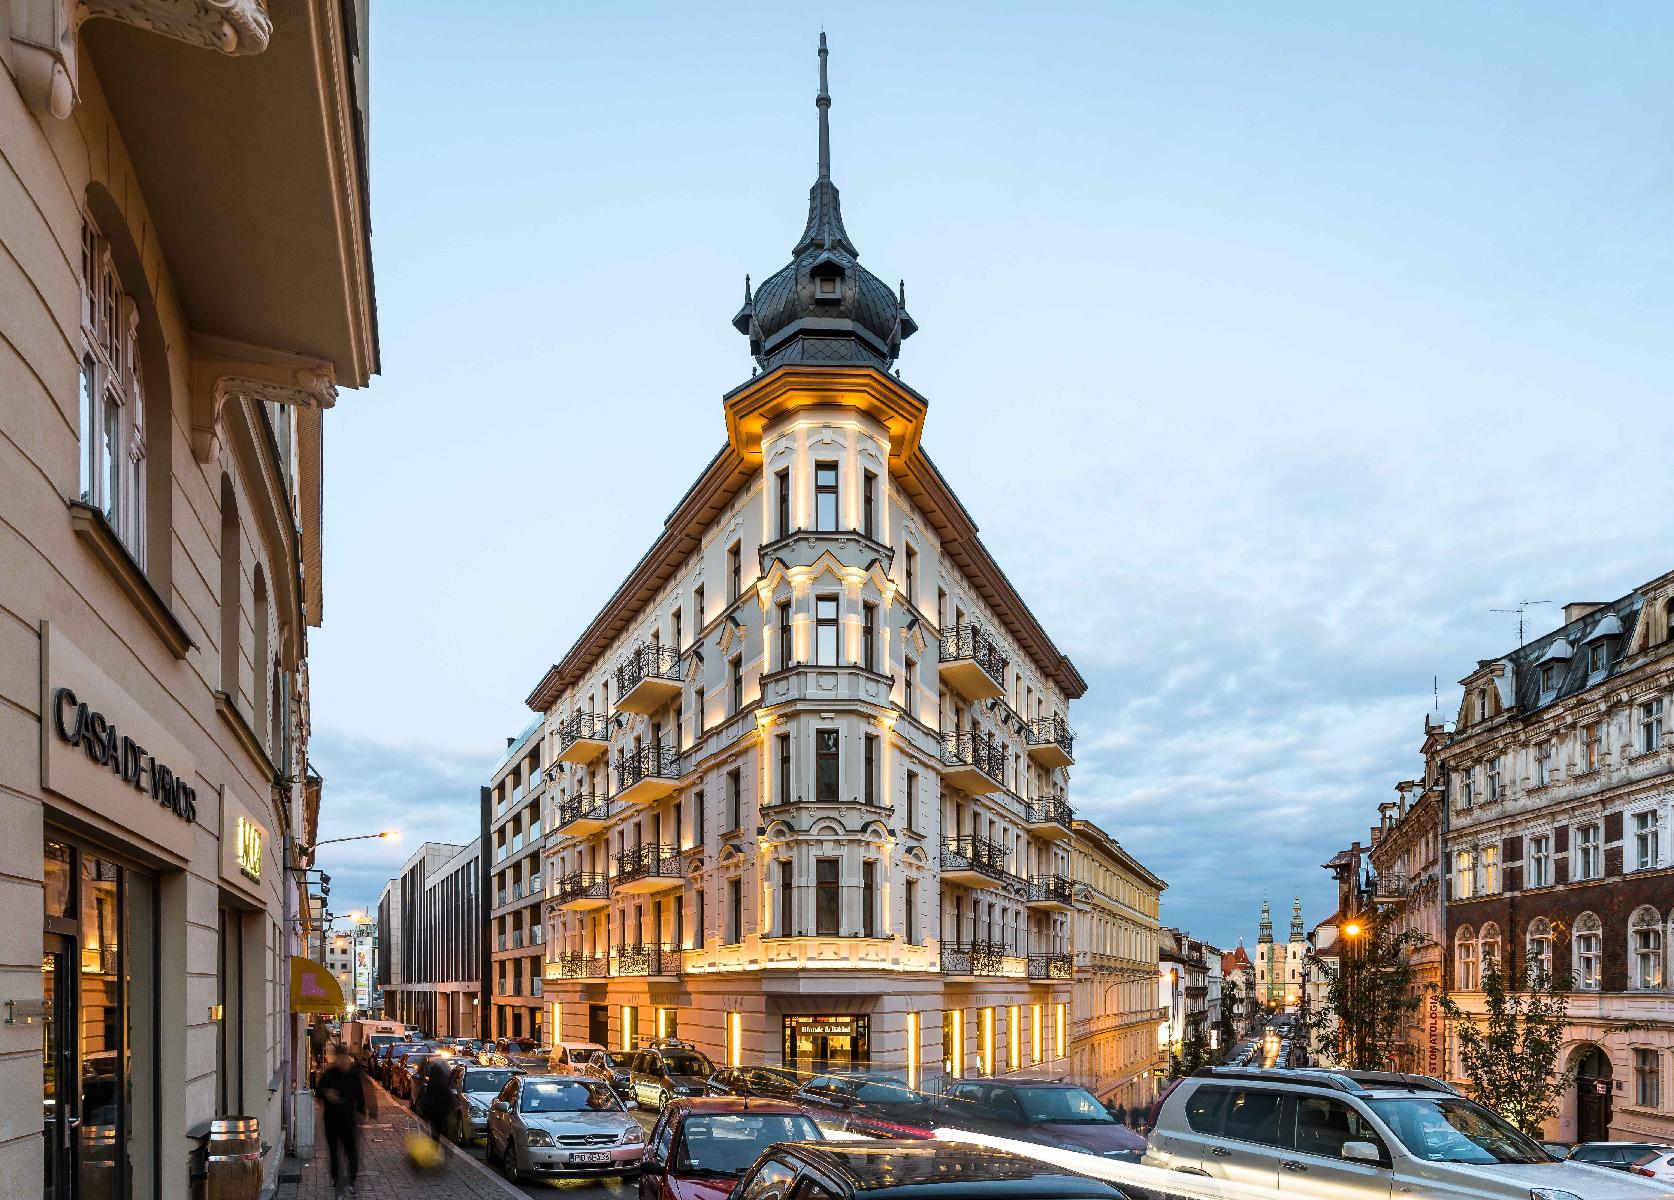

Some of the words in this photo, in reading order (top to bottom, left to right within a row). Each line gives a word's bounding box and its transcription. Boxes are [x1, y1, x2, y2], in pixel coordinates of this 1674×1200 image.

[54, 687, 120, 775] CASA
[122, 735, 149, 793] DE
[1429, 995, 1438, 1073] STOMATOLOGIA
